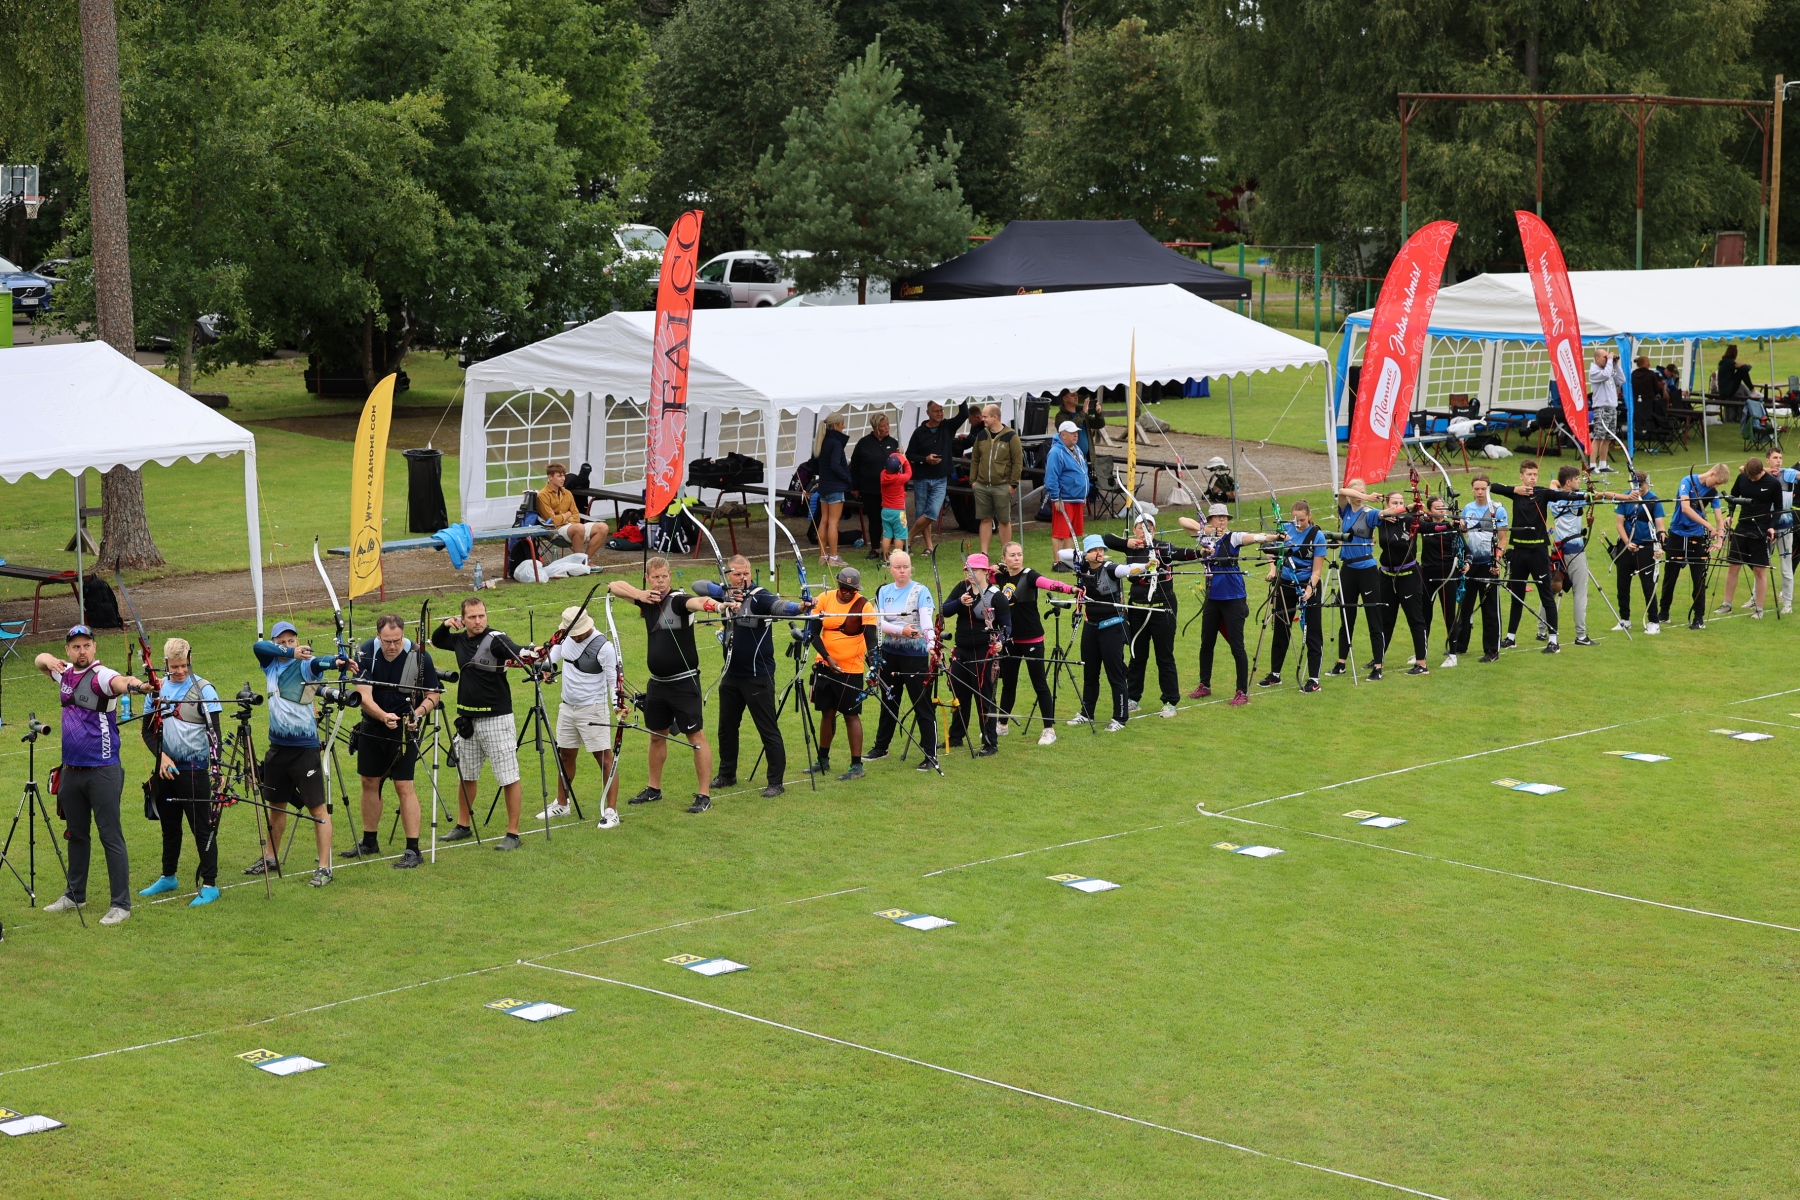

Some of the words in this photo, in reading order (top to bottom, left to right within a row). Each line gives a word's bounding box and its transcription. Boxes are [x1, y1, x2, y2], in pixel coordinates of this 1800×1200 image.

[1389, 314, 1409, 356] Juba
[1404, 261, 1422, 313] valmis!
[1374, 367, 1394, 429] Mamma
[490, 998, 524, 1009] 24
[242, 1049, 276, 1062] 25
